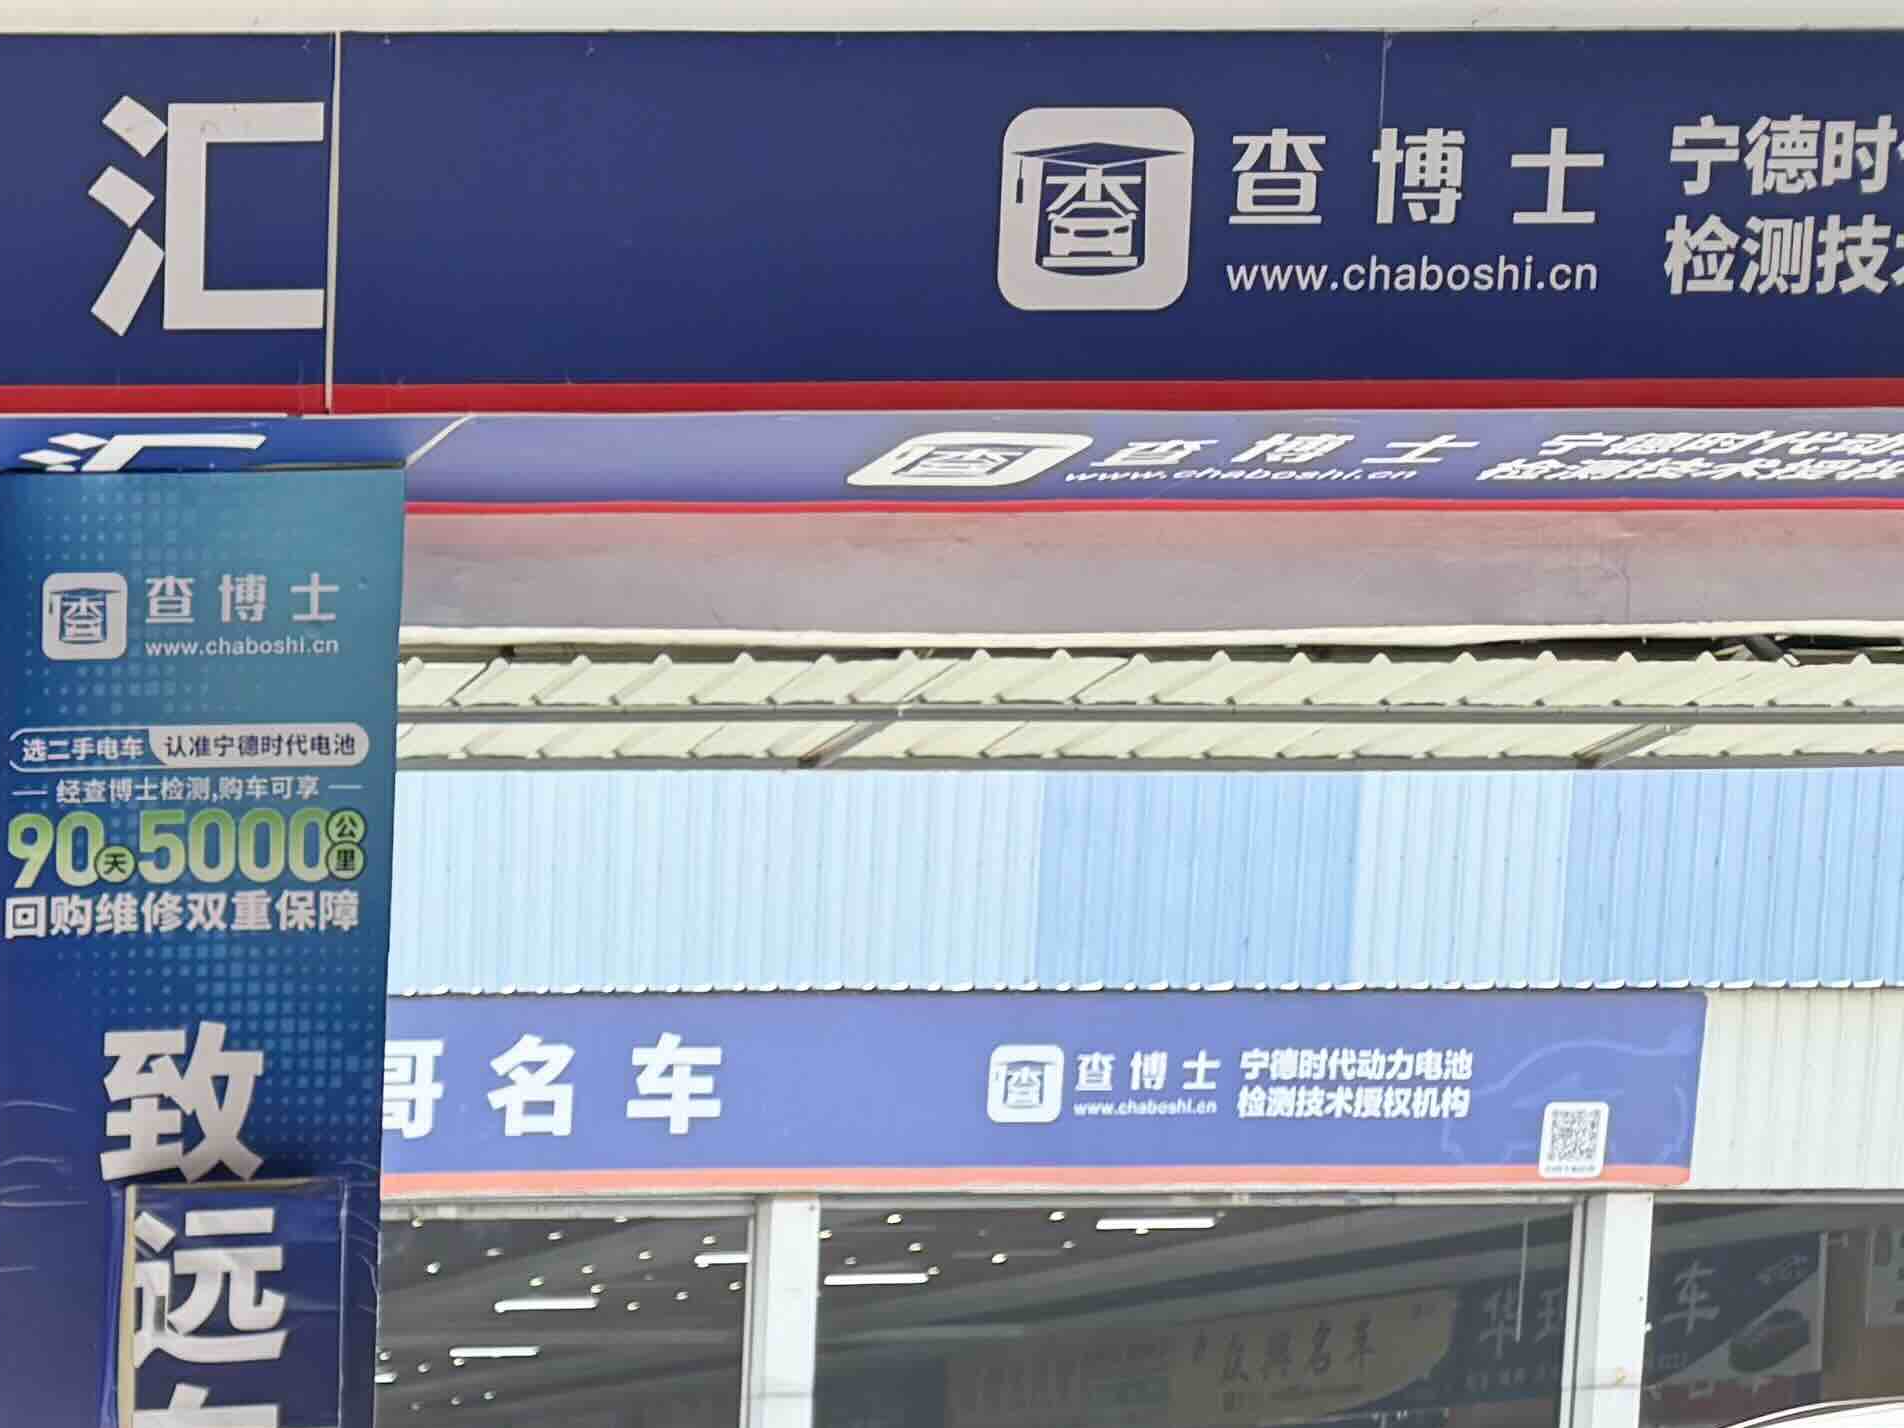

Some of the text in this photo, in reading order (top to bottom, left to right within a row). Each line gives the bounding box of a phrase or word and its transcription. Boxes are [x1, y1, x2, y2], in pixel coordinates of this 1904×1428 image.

[1669, 113, 1904, 196] 宁德时
[1228, 127, 1604, 226] 查博士
[1226, 255, 1599, 293] www.chaboshi.cn
[1663, 212, 1904, 296] 检测技
[144, 572, 340, 624] 查博士
[144, 636, 339, 657] www.chaboshi.cn
[22, 732, 357, 762] 选二手电车 认准宁德时代电池
[4, 889, 361, 940] 回购维修双重保障
[1075, 1051, 1221, 1093] 查博士
[1238, 1046, 1474, 1083] 宁德时代动力电池
[1237, 1084, 1472, 1120] 检测技术授权机构
